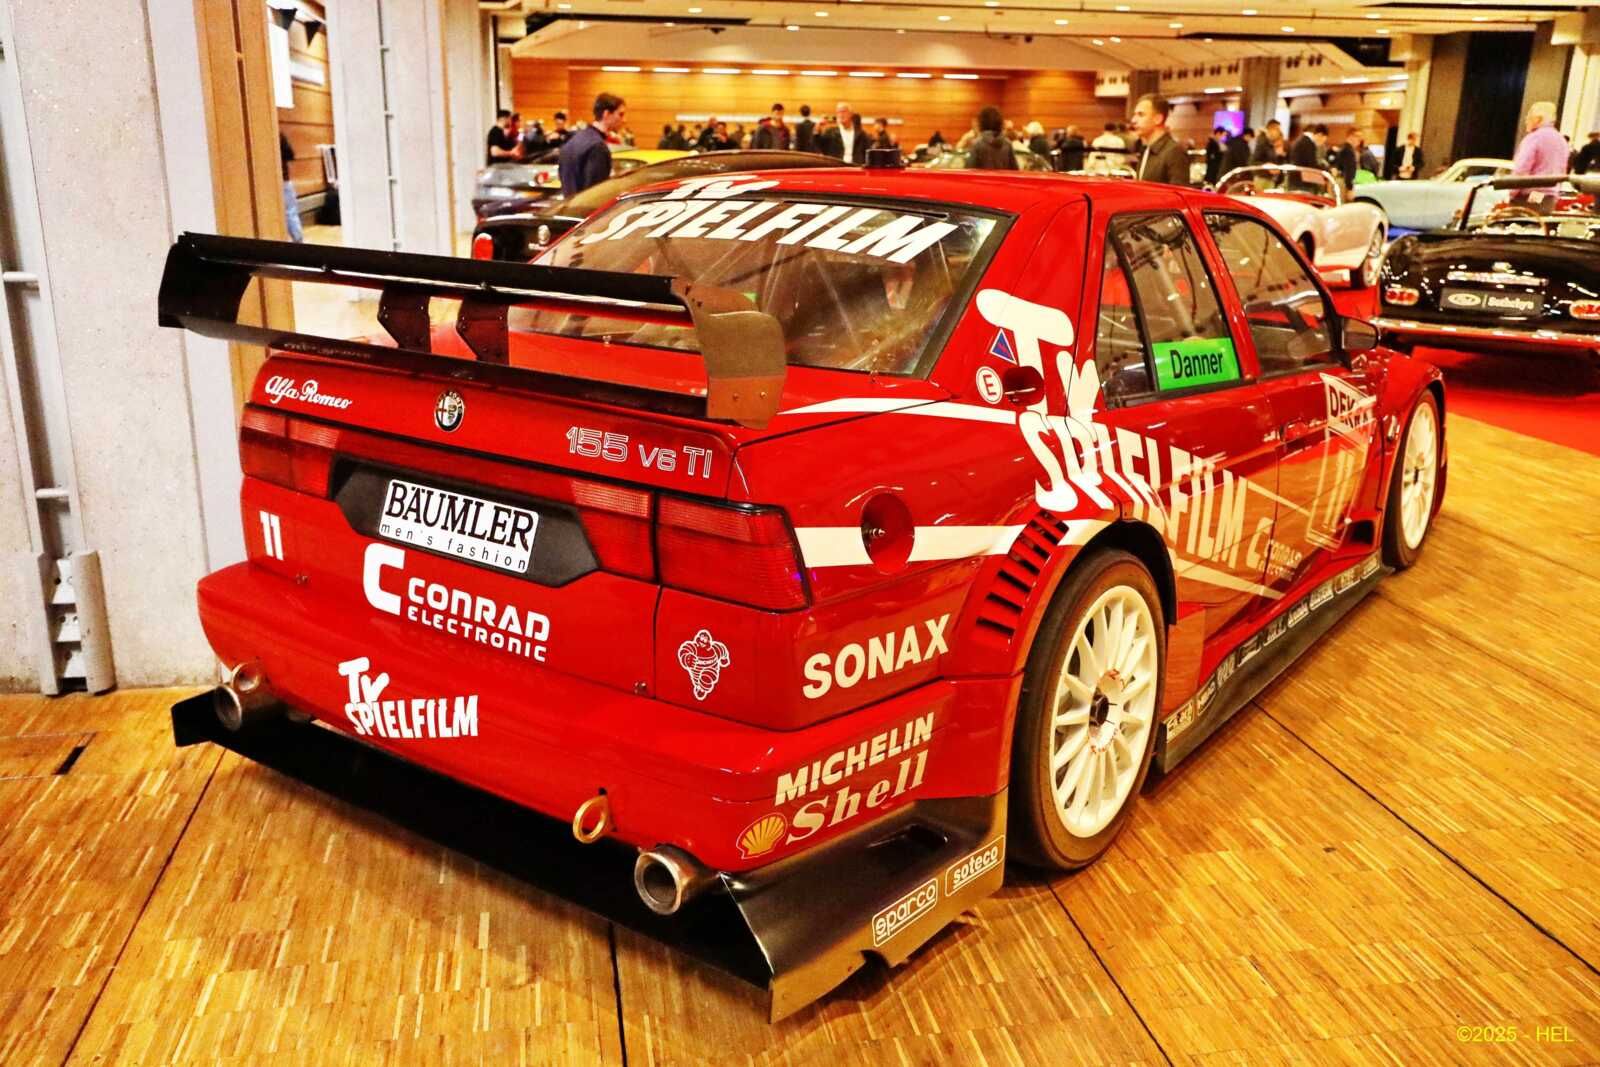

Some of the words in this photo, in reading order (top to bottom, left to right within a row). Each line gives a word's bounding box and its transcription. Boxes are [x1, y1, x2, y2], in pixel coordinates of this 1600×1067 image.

[580, 199, 958, 264] SPIELFILM
[982, 374, 997, 396] E
[1169, 349, 1224, 380] Danner
[264, 375, 299, 404] Alfa
[299, 379, 353, 409] Romeo
[565, 426, 629, 462] 155
[638, 444, 676, 471] V6
[682, 445, 713, 479] TI
[1018, 408, 1249, 570] SPIELFILM
[259, 510, 284, 561] 11
[384, 482, 535, 552] BÄUMLER
[446, 538, 527, 571] fashion
[407, 577, 551, 642] CONRAD
[407, 606, 547, 662] ELECTRONIC
[802, 614, 950, 699] SONAX
[344, 694, 479, 739] SPIELFILM
[774, 712, 934, 806] MICHELIN
[786, 749, 929, 845] Shell
[953, 846, 998, 884] soteco
[876, 885, 936, 937] sparco
